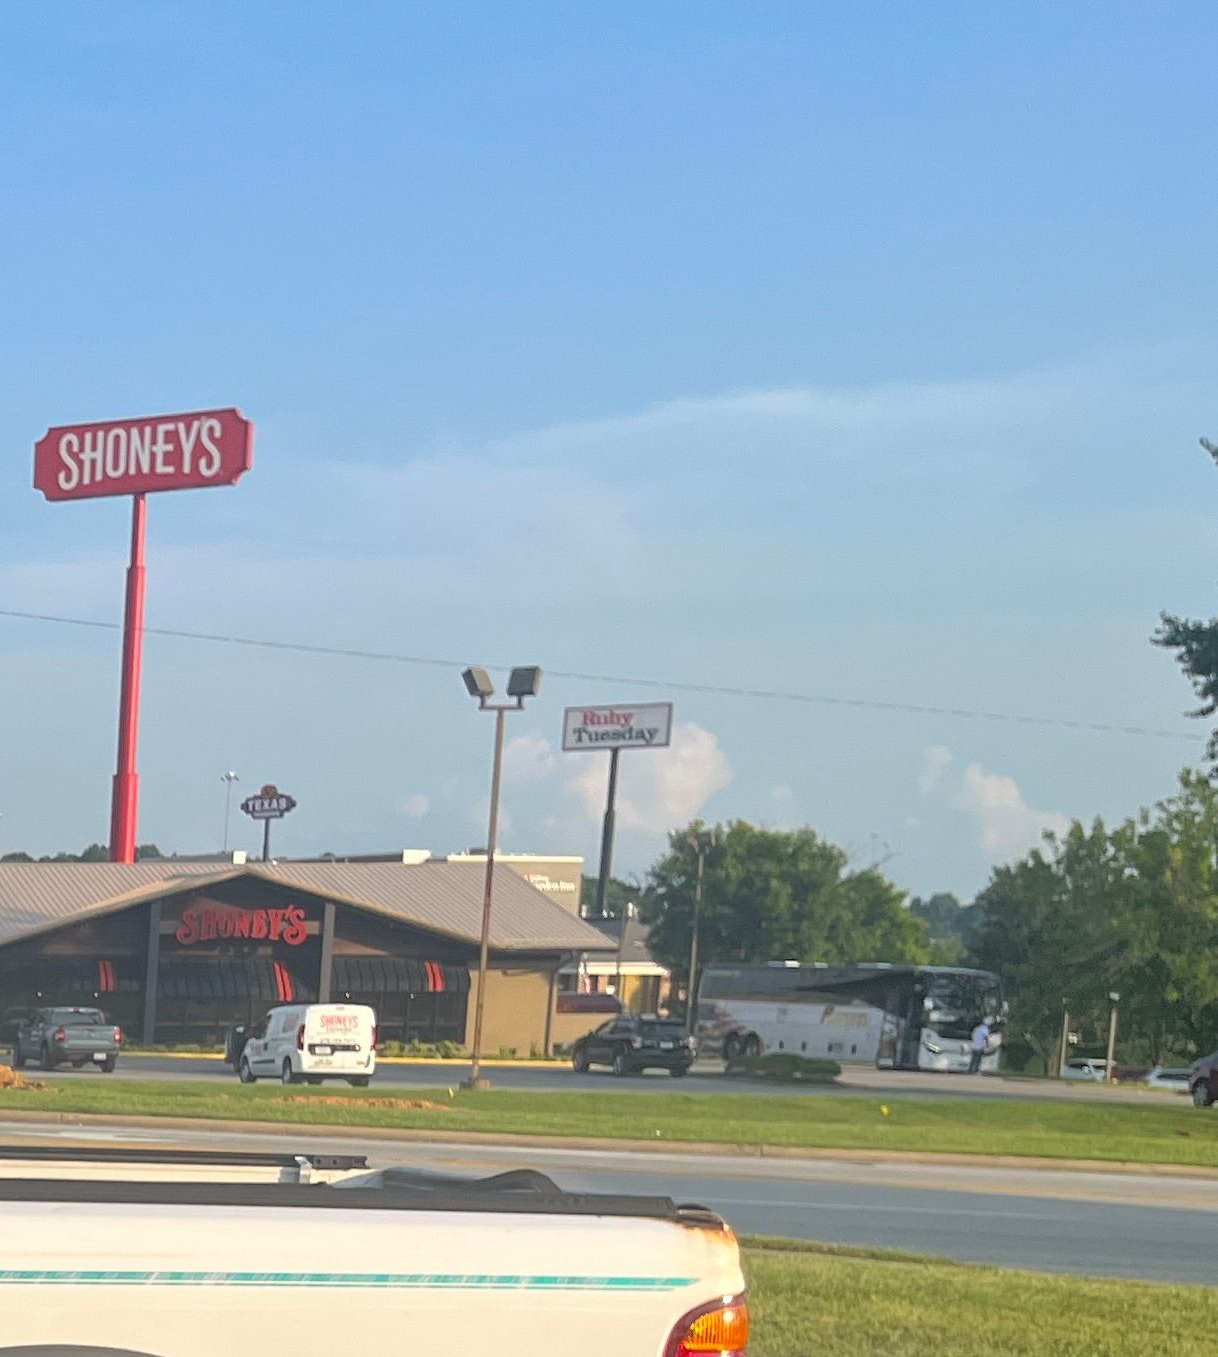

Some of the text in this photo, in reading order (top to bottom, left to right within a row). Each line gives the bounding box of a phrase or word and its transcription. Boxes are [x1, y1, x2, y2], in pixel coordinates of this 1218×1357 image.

[582, 709, 634, 728] Ruby
[572, 726, 659, 744] Tuesday
[247, 798, 287, 811] TEXAS
